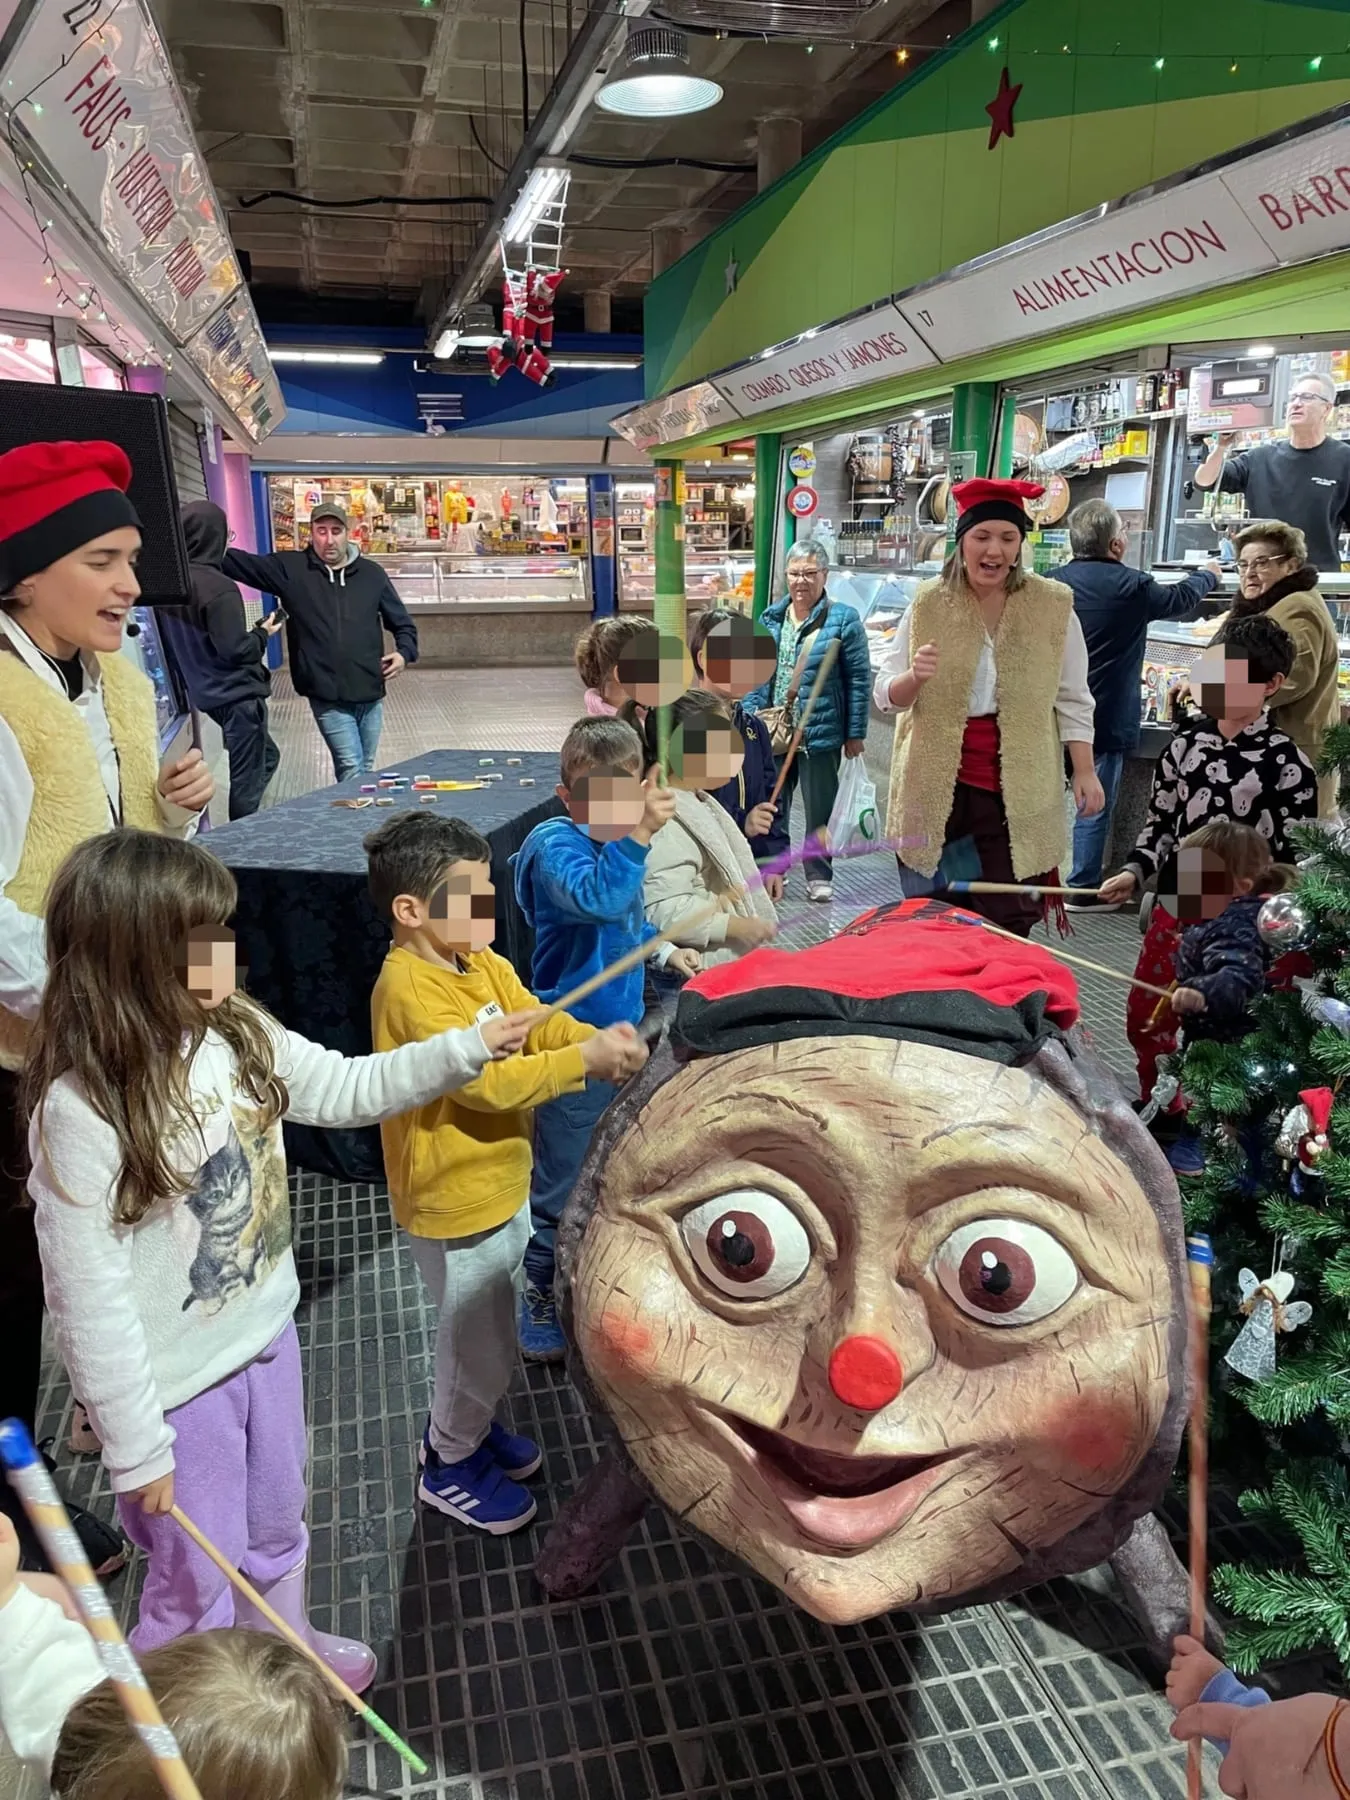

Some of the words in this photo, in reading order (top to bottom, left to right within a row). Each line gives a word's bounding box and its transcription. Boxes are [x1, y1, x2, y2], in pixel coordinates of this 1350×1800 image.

[65, 54, 131, 151] FAUS
[111, 144, 177, 245] HUEVERIA
[1012, 220, 1227, 316] ALIMENTACION
[917, 310, 935, 328] 17
[741, 373, 791, 402] COLMADO
[789, 358, 836, 388] QUESOS
[828, 354, 847, 373] Y
[842, 332, 908, 370] JAMONES
